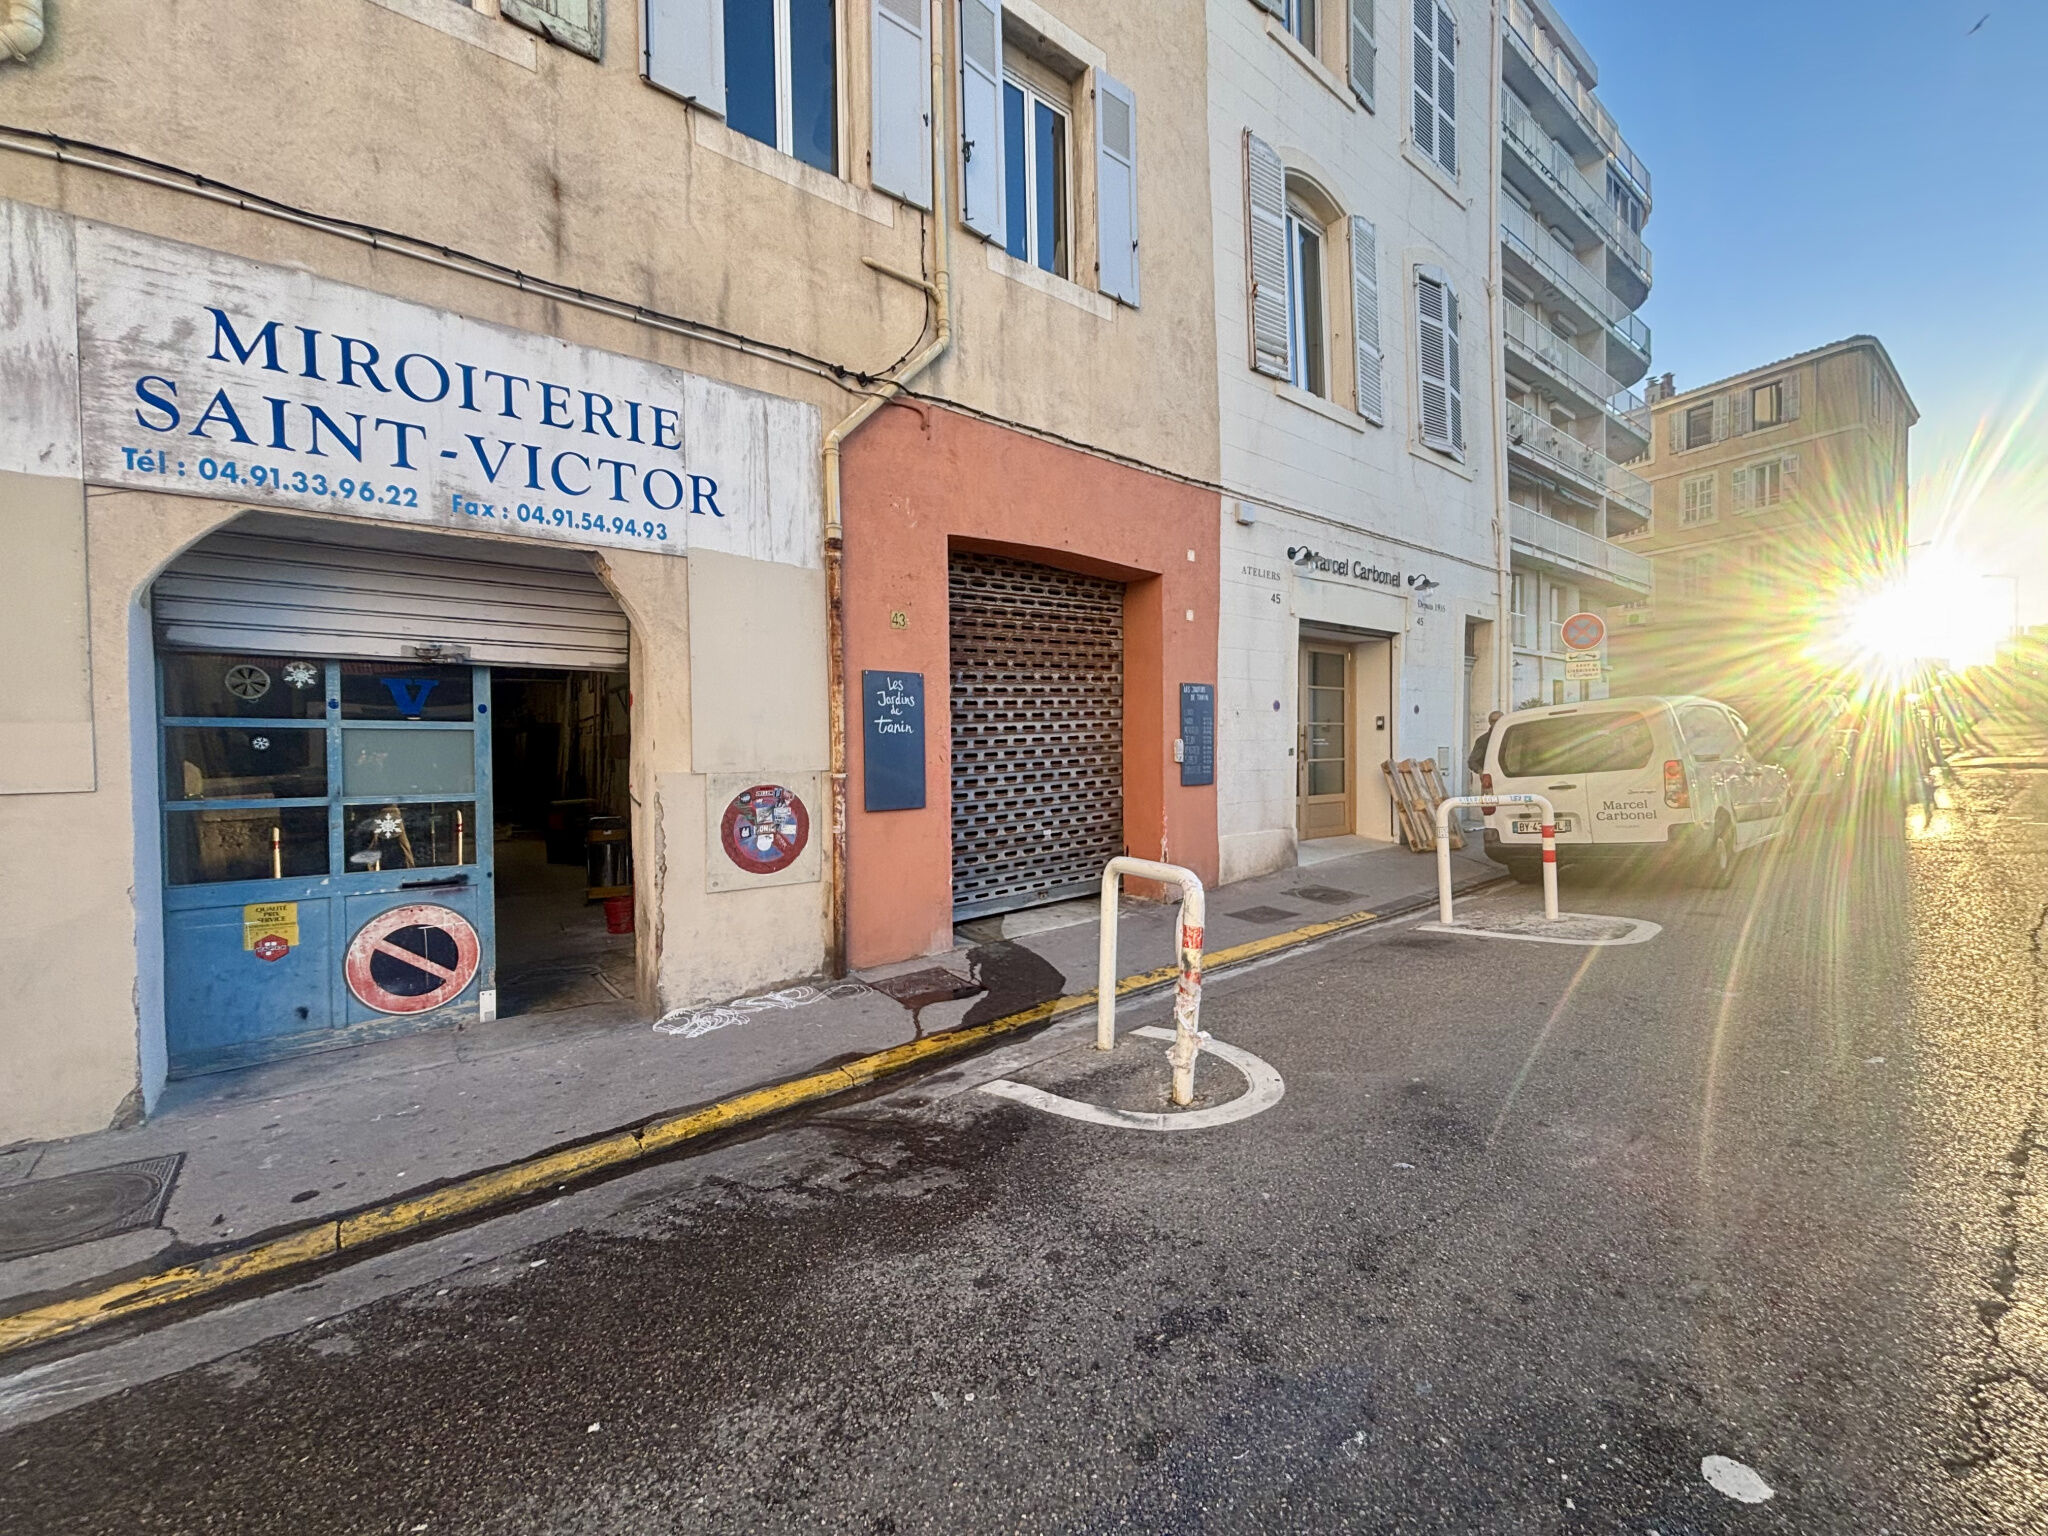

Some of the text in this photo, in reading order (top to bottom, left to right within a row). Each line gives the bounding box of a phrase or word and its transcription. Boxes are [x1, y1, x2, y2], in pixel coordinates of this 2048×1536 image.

[203, 306, 682, 451] MIROITERIE
[198, 457, 418, 508] 04.91.33.96.22
[516, 502, 668, 541] 04.91.54.94.93
[1241, 566, 1281, 582] ATELIERS
[1353, 560, 1401, 587] Carbonel
[1271, 593, 1281, 604] 45
[891, 612, 906, 627] 43
[1417, 617, 1424, 626] 45
[887, 677, 904, 691] Les
[877, 690, 915, 707] Jardins
[1603, 799, 1648, 811] Marcel
[1596, 810, 1657, 821] Carbonel
